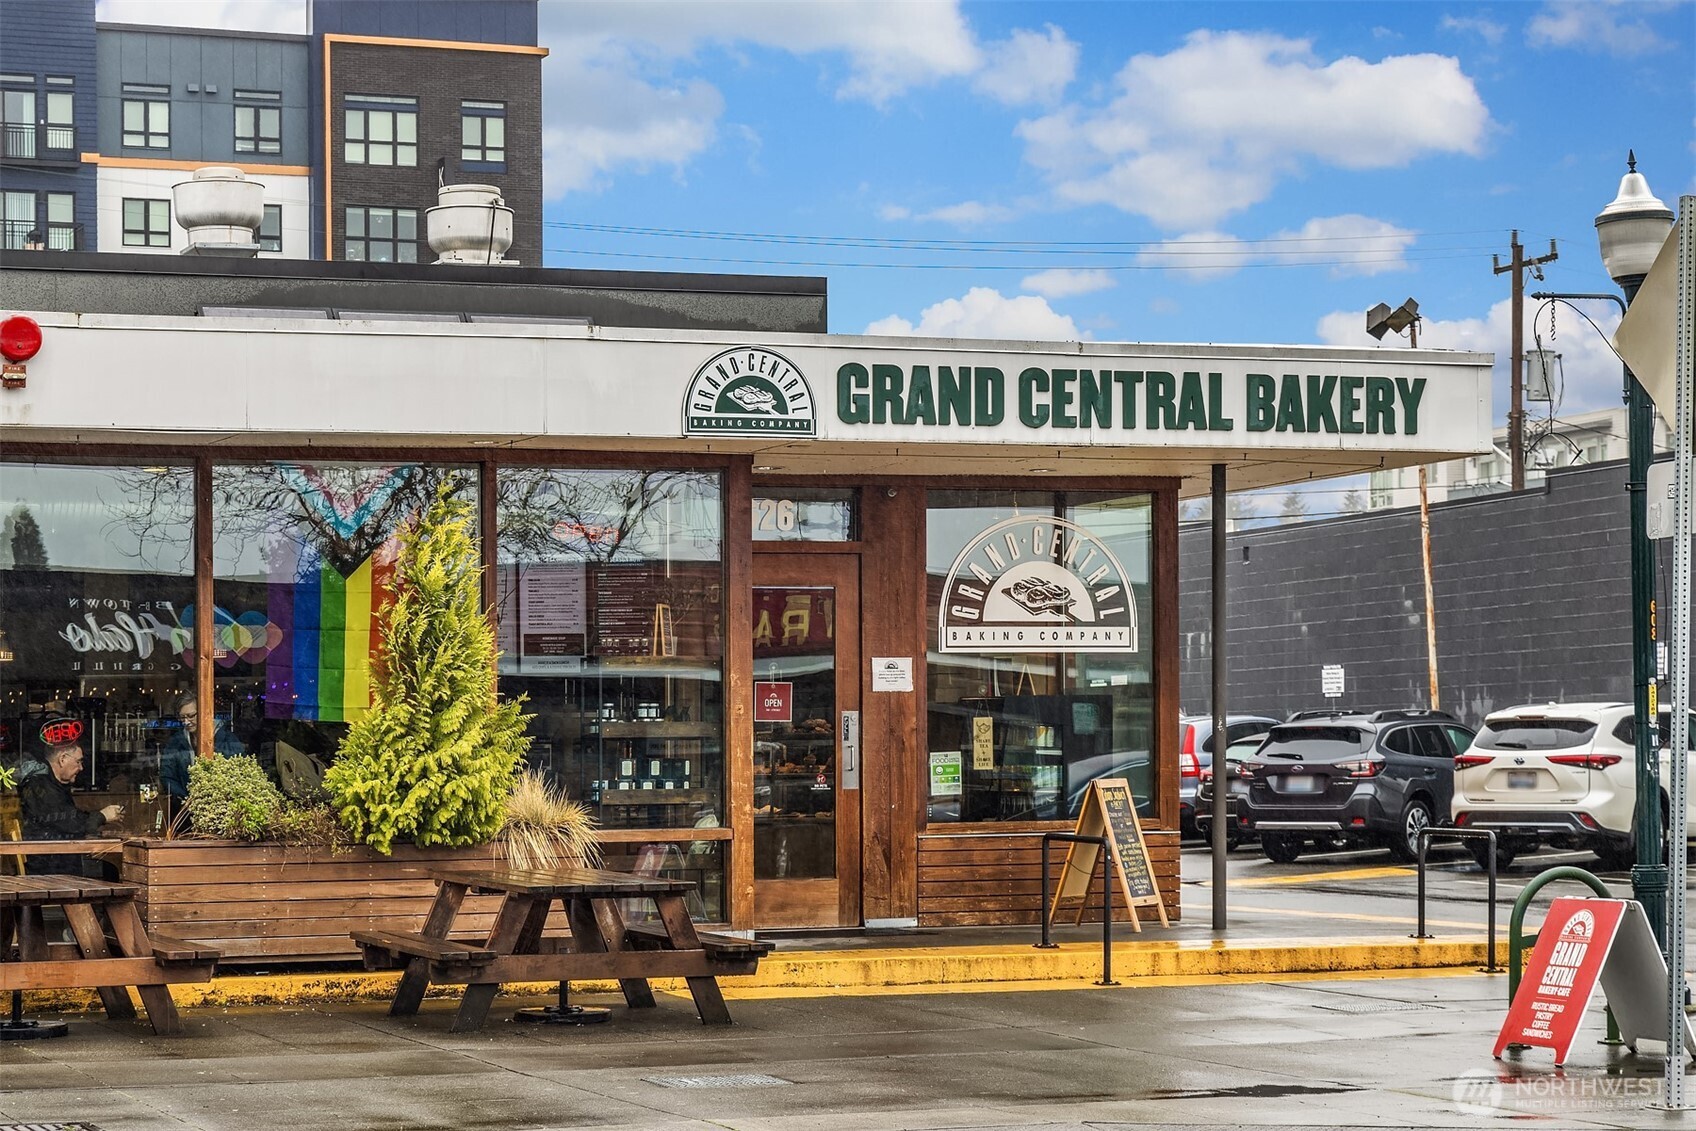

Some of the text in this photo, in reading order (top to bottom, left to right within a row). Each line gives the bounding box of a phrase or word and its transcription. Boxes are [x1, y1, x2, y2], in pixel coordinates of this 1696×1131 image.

[693, 353, 808, 413] GRAND CENTRAL
[837, 362, 1428, 435] GRAND CENTRAL BAKERY
[693, 418, 808, 429] BAKING COMPANY
[951, 525, 1125, 620] GRAND CENTRAL
[952, 631, 1125, 641] BAKING COMPANY
[764, 698, 783, 708] OPEN
[1549, 941, 1589, 968] GRAND
[1541, 965, 1578, 987] CENTRAL
